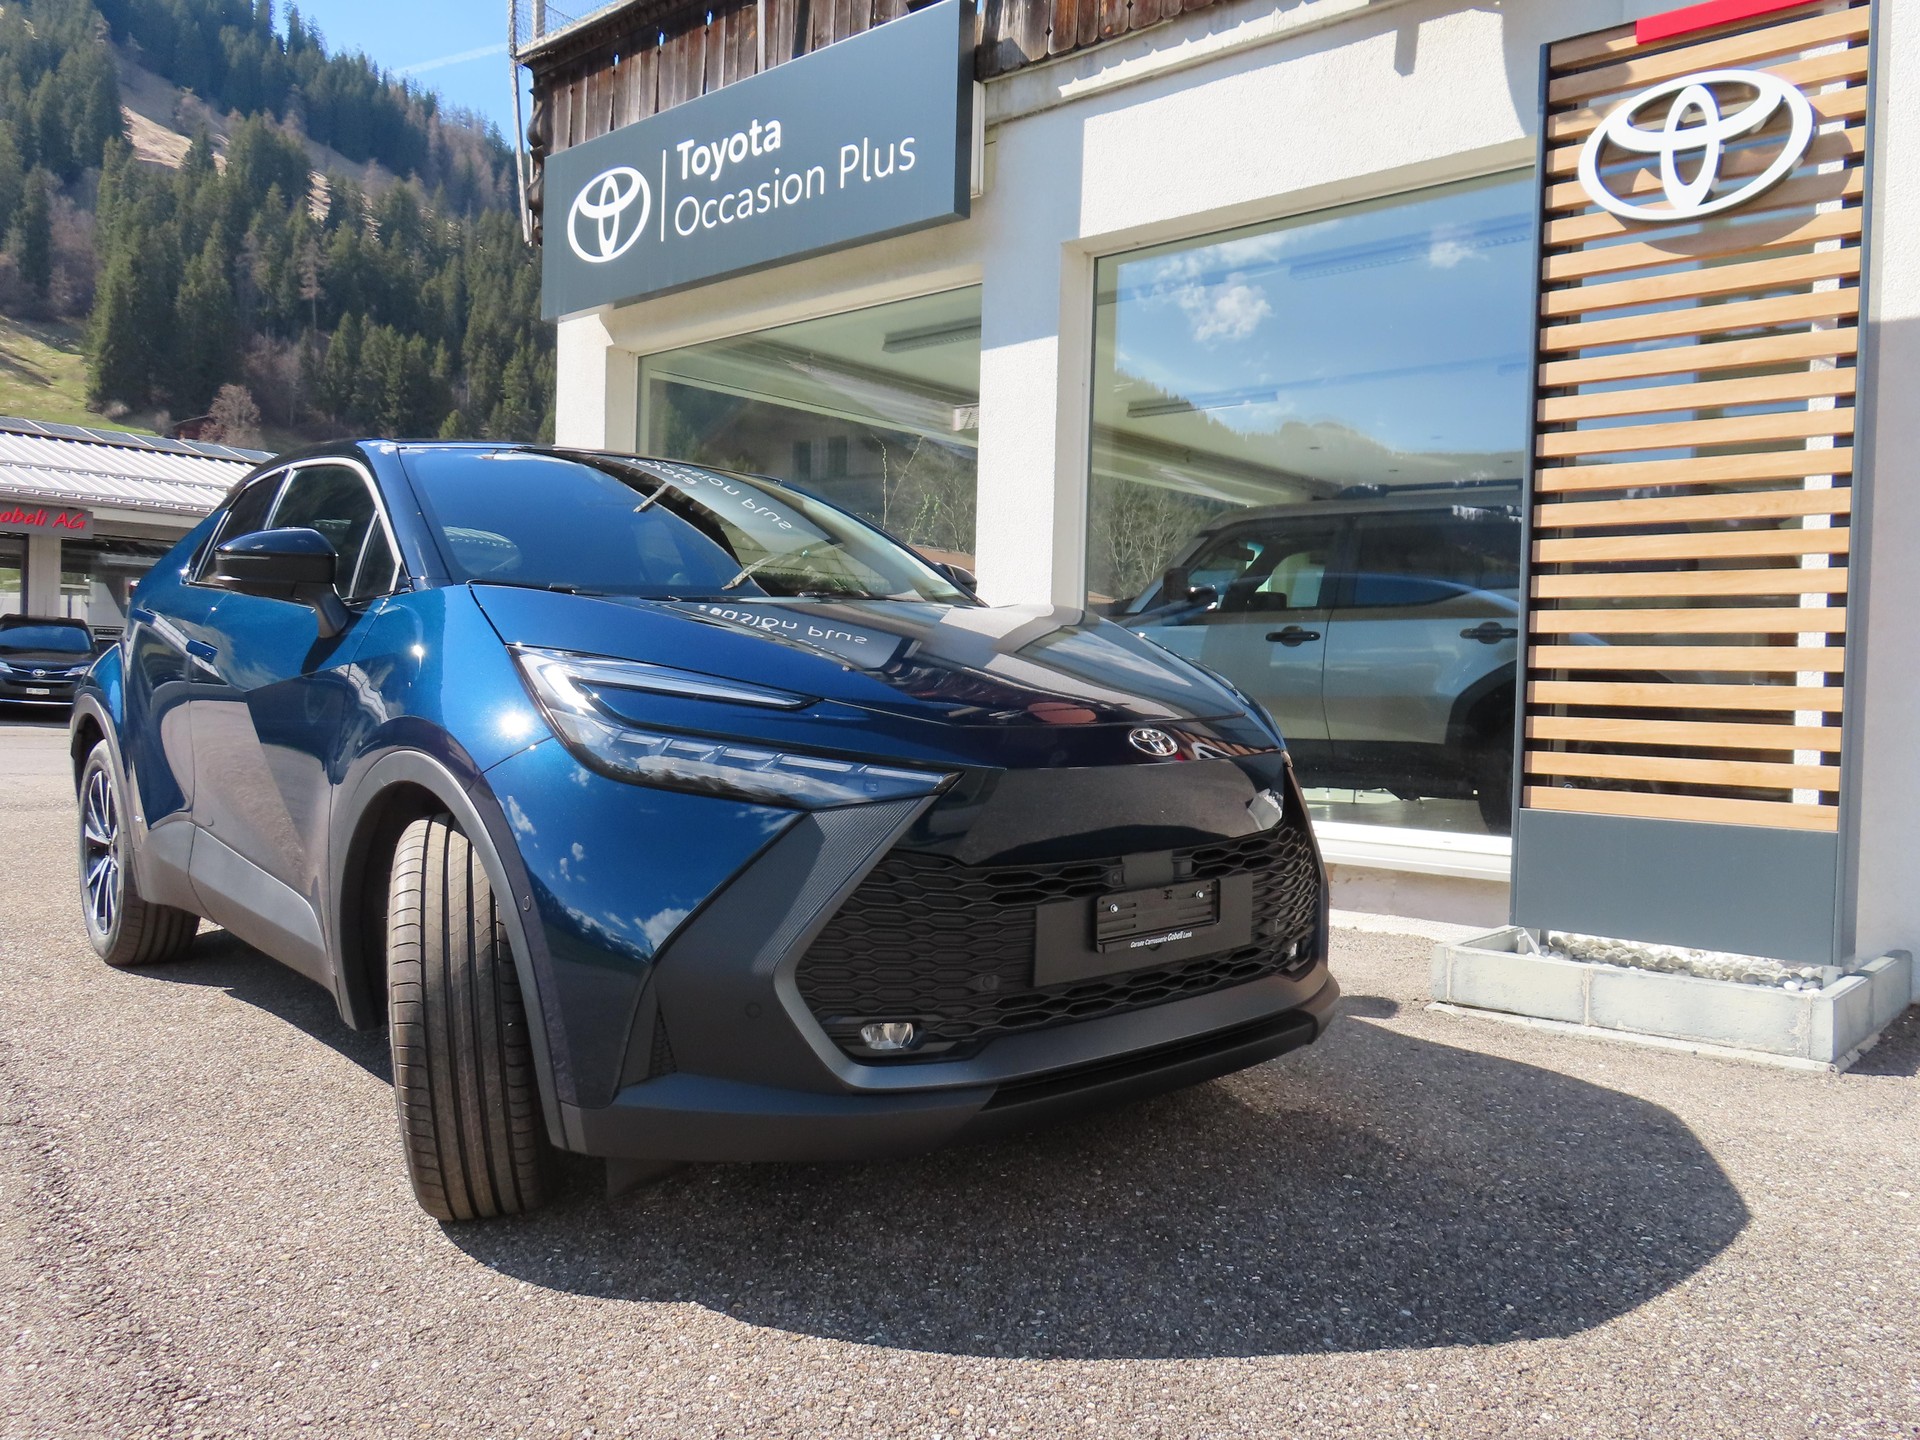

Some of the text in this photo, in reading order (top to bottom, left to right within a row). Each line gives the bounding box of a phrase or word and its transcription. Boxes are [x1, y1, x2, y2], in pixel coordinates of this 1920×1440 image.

[677, 119, 782, 181] Toyota
[675, 136, 916, 236] Occasion Plus
[0, 506, 87, 530] obeli AG
